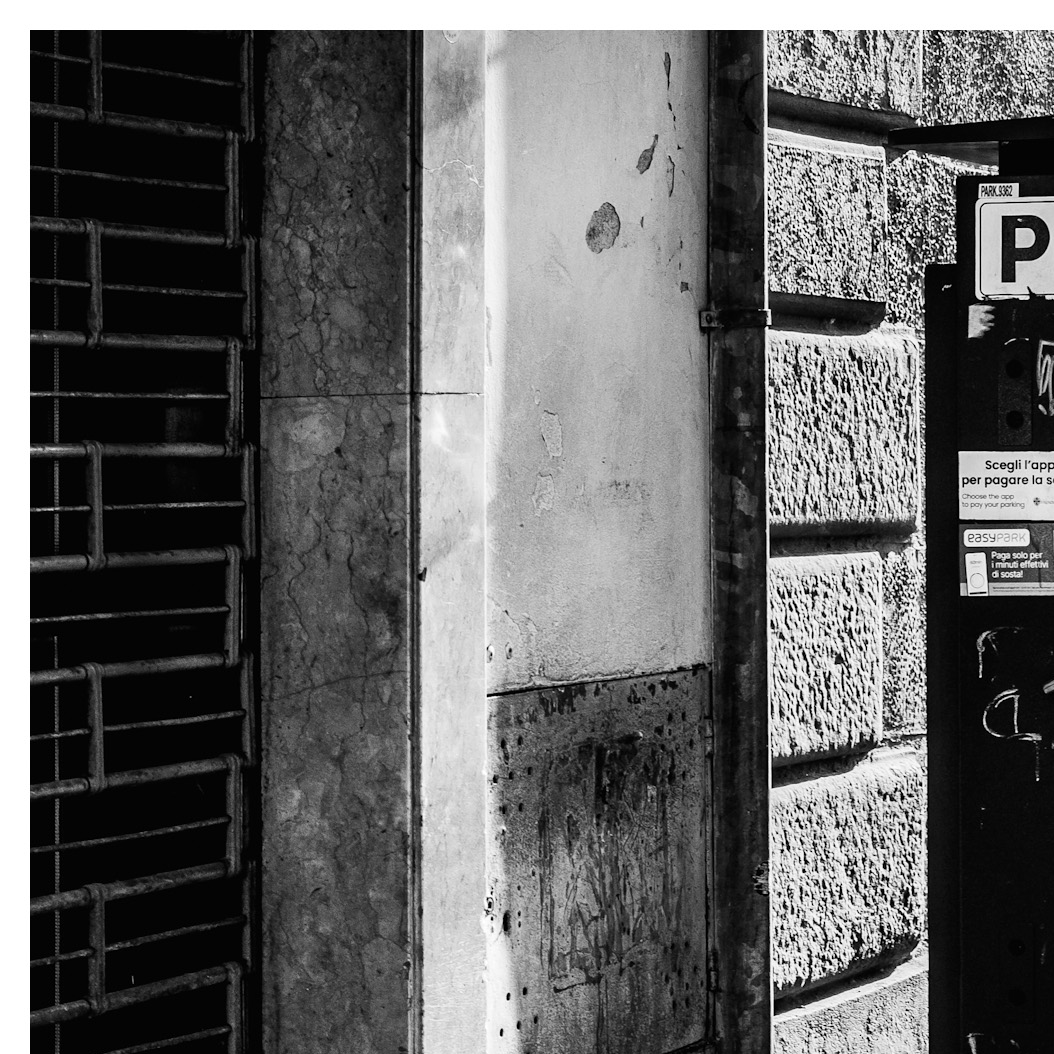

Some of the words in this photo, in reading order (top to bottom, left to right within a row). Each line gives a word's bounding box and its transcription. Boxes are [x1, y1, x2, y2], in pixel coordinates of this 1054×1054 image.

[1001, 215, 1050, 283] P
[985, 459, 1022, 473] Scegli
[961, 476, 982, 488] per
[984, 476, 1029, 488] pagare
[1032, 474, 1043, 485] la
[1000, 501, 1025, 510] parking
[991, 551, 1011, 562] Paga
[1012, 551, 1029, 560] solo
[1029, 552, 1043, 561] per
[991, 560, 995, 569] i
[995, 560, 1019, 569] minuti
[1019, 559, 1049, 569] effettivi
[991, 569, 1000, 578] di
[1000, 569, 1024, 579] sosta!
